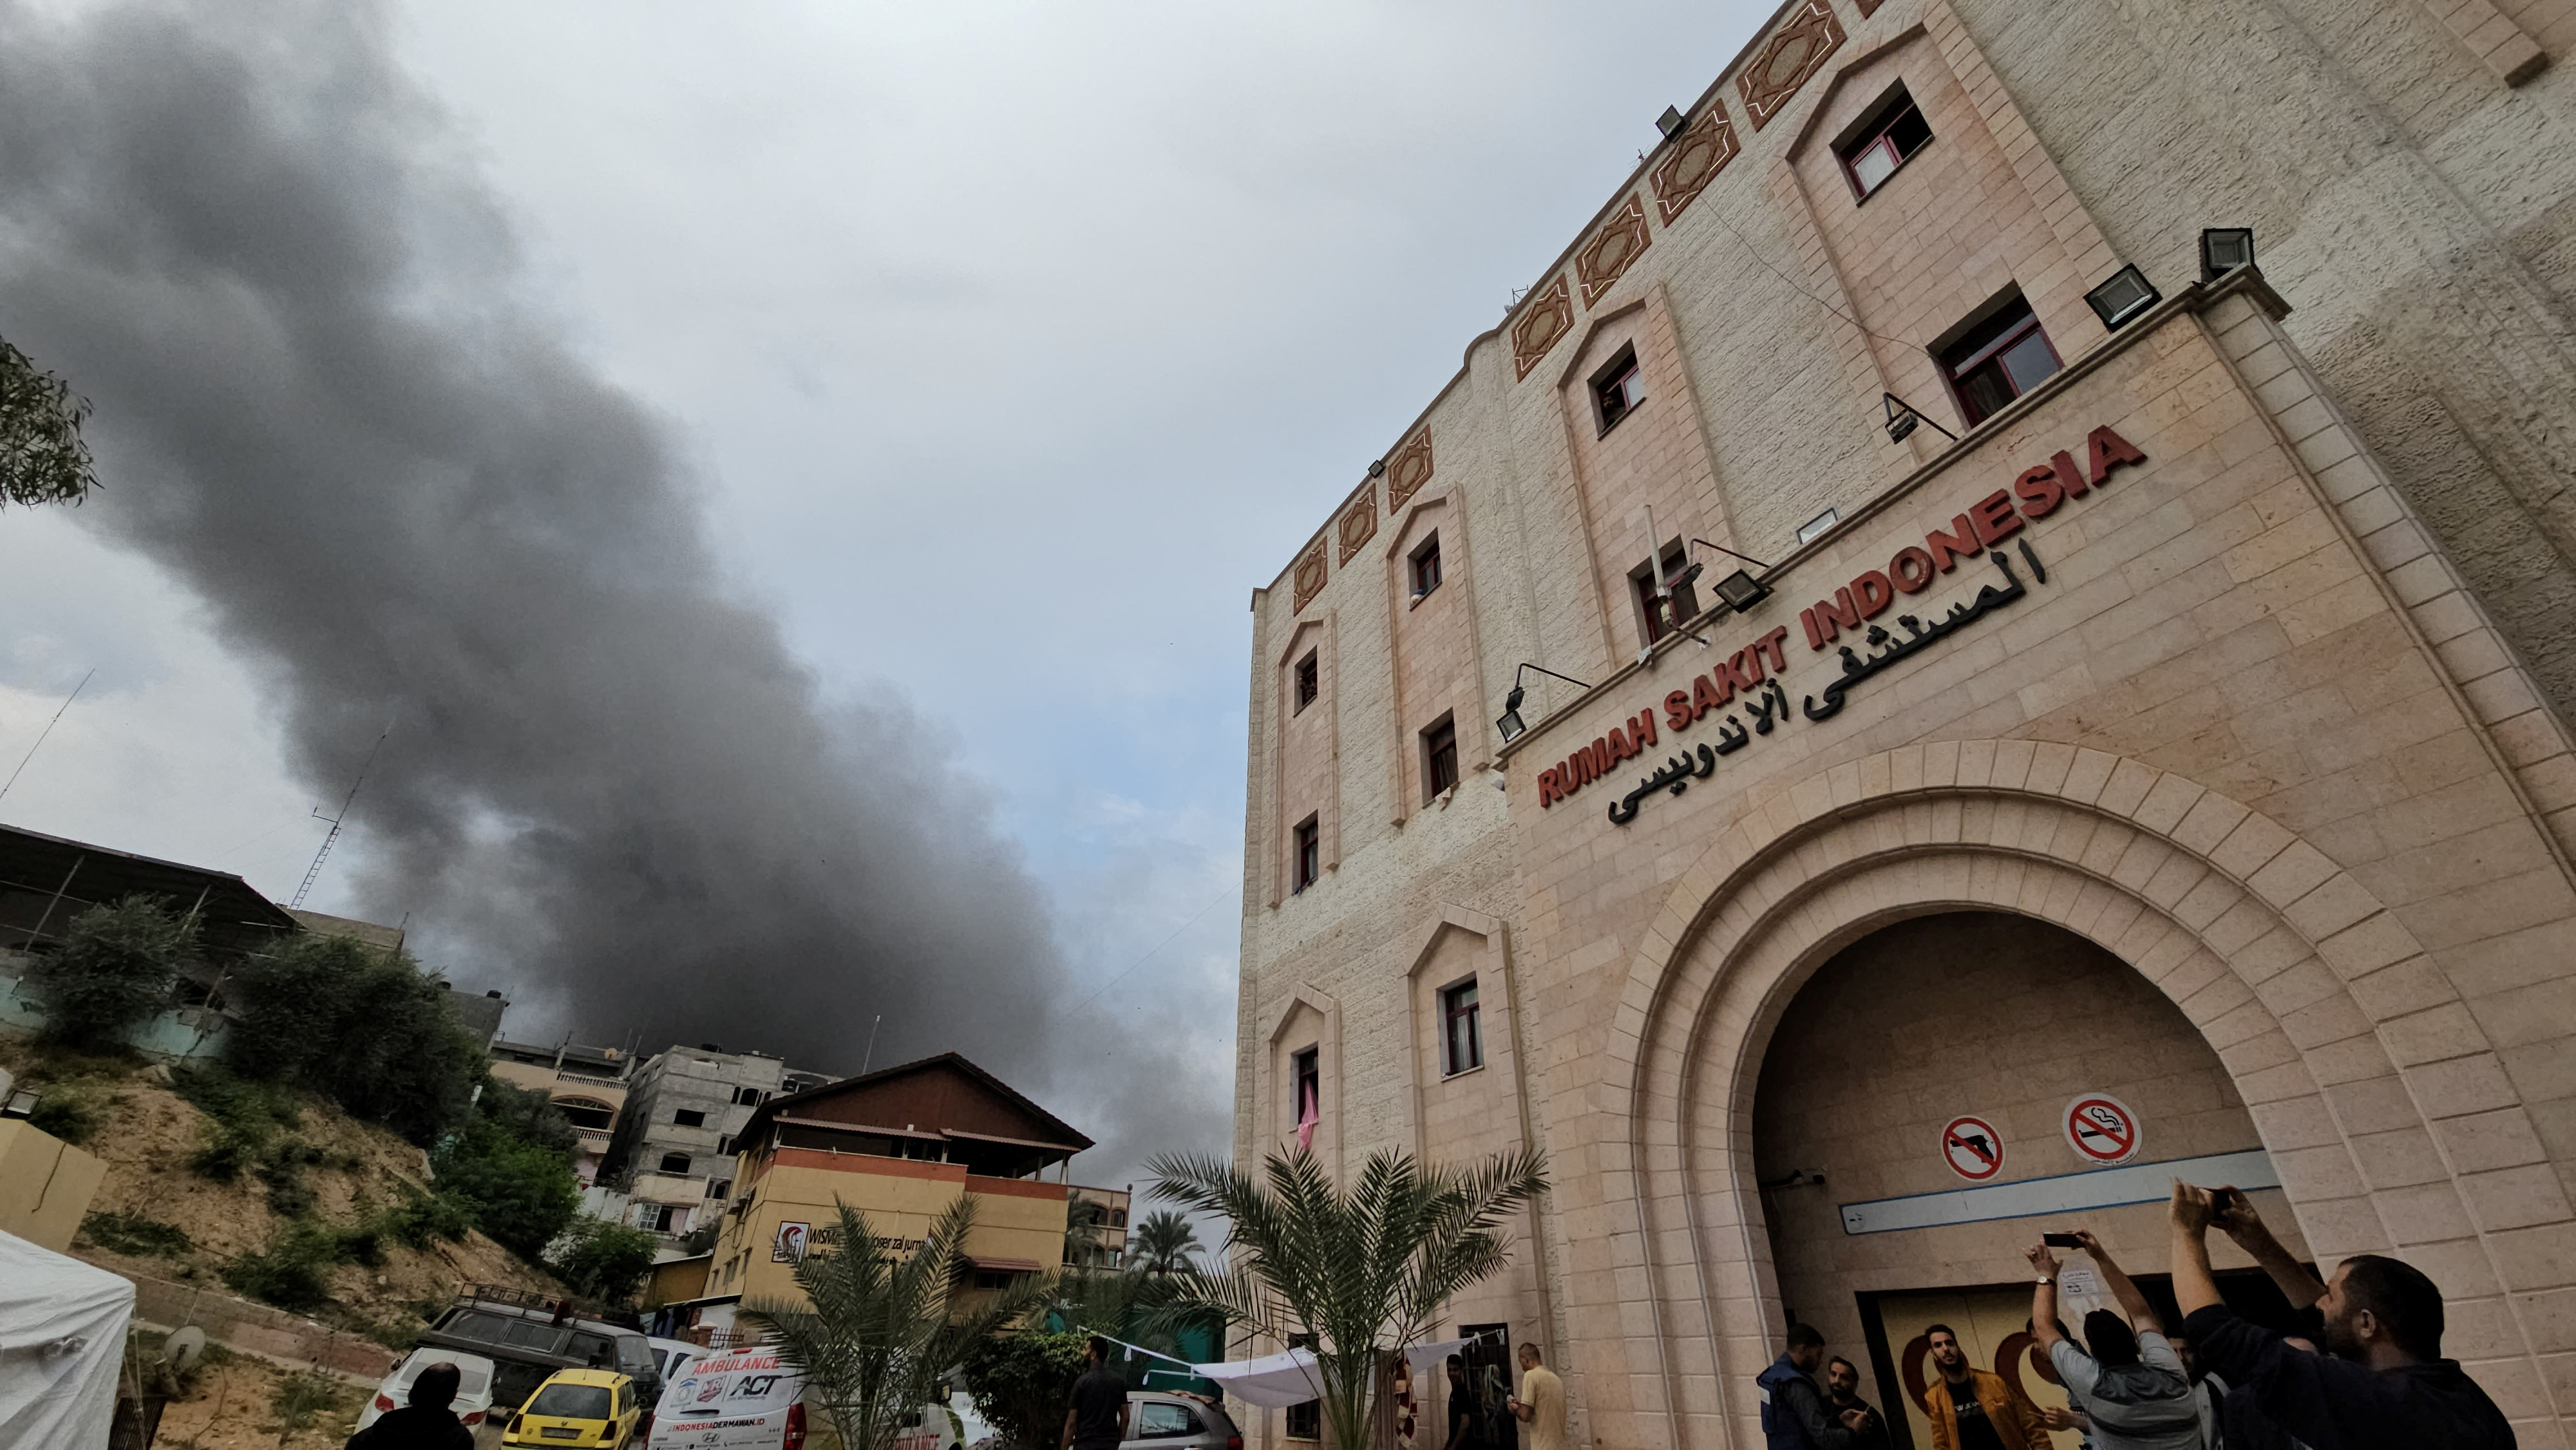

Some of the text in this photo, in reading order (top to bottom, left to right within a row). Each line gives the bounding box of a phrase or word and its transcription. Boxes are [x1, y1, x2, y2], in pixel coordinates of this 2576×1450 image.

[1537, 424, 2147, 808] RUMAH SAKIT INDONESIA
[692, 1356, 780, 1376] AMBULANCE
[729, 1375, 782, 1397] ACT
